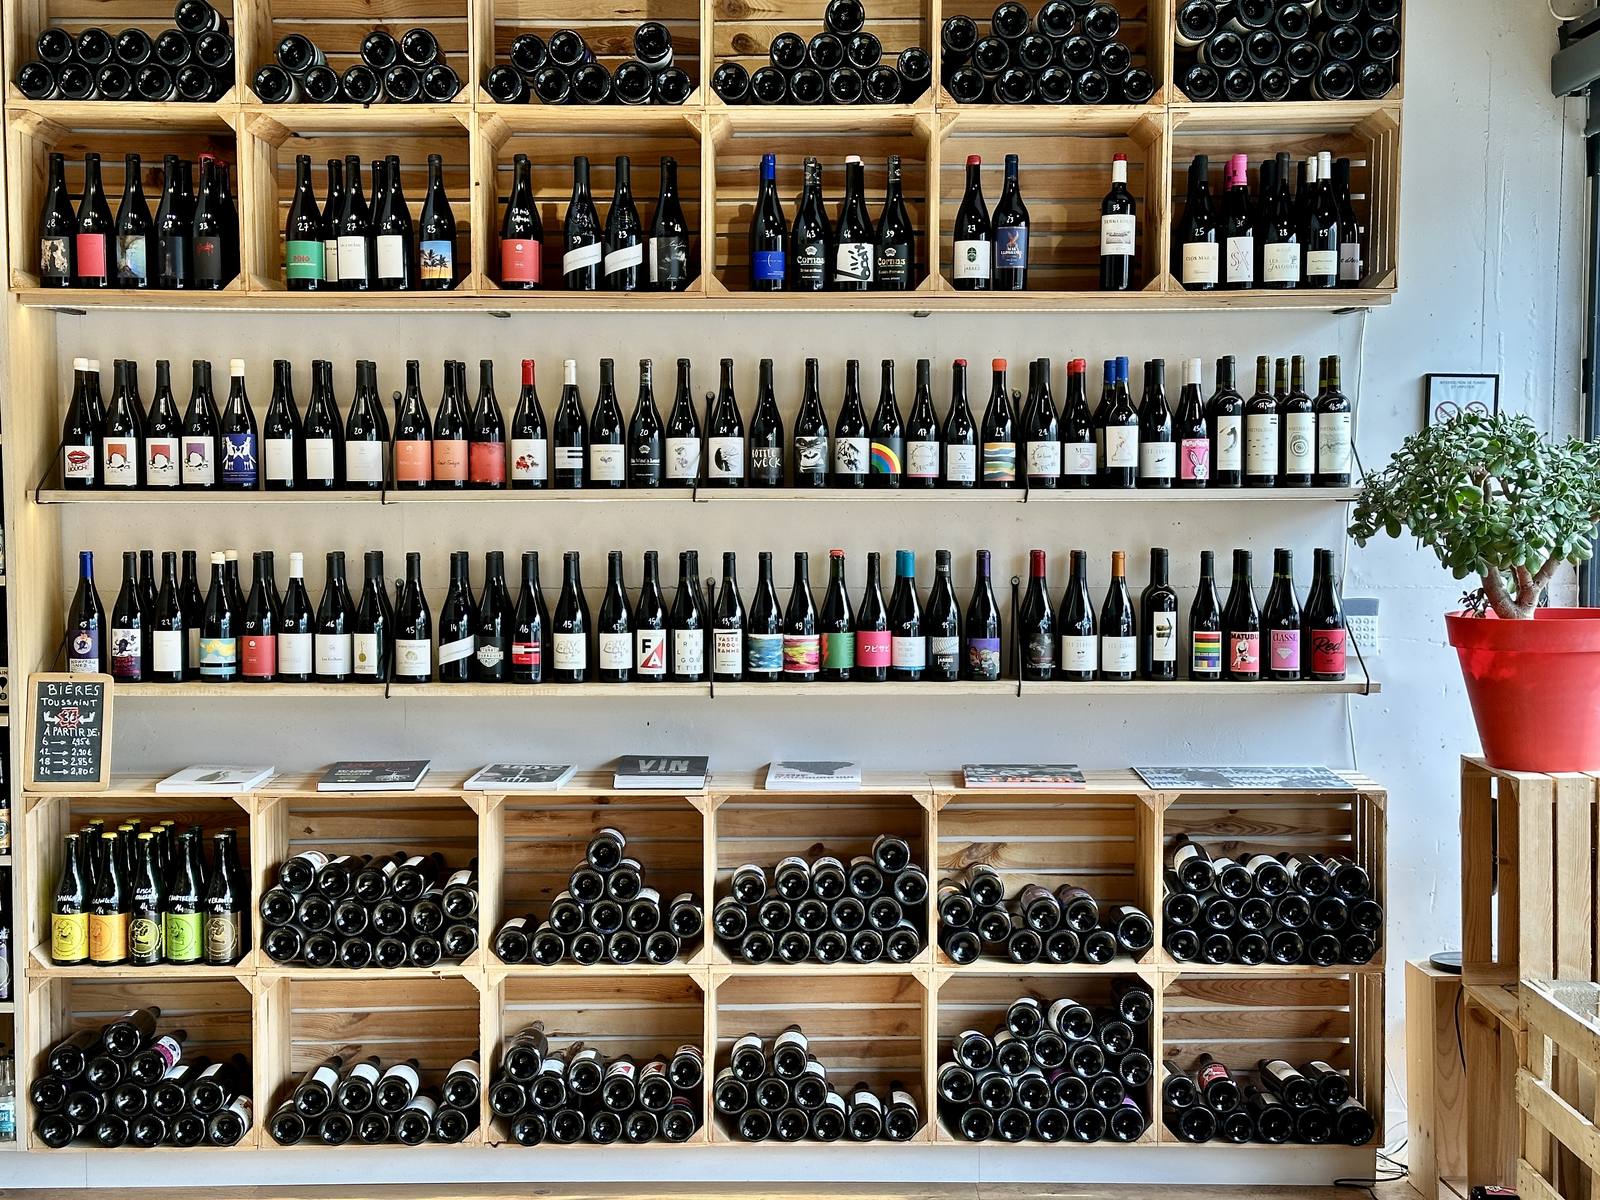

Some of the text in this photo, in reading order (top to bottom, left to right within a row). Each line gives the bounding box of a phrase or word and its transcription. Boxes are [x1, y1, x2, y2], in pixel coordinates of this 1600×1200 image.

[298, 222, 308, 232] 27
[346, 222, 356, 232] 27
[426, 224, 436, 234] 25
[806, 230, 816, 238] 43
[1194, 228, 1204, 236] 25
[572, 236, 582, 244] 39
[878, 258, 906, 266] Cornas
[156, 423, 166, 431] 20
[354, 427, 362, 435] 20
[640, 428, 649, 436] 20
[754, 458, 782, 468] NECK
[284, 620, 294, 628] 20
[562, 620, 572, 628] 15
[1326, 616, 1334, 624] 16
[520, 624, 528, 634] 16
[795, 622, 803, 630] 19
[642, 638, 652, 654] F
[1315, 636, 1343, 652] Red
[44, 724, 50, 736] À
[52, 726, 86, 737] PARTIR
[42, 736, 49, 746] 6
[39, 758, 50, 766] 18
[638, 759, 690, 770] VIN
[40, 767, 50, 775] 24
